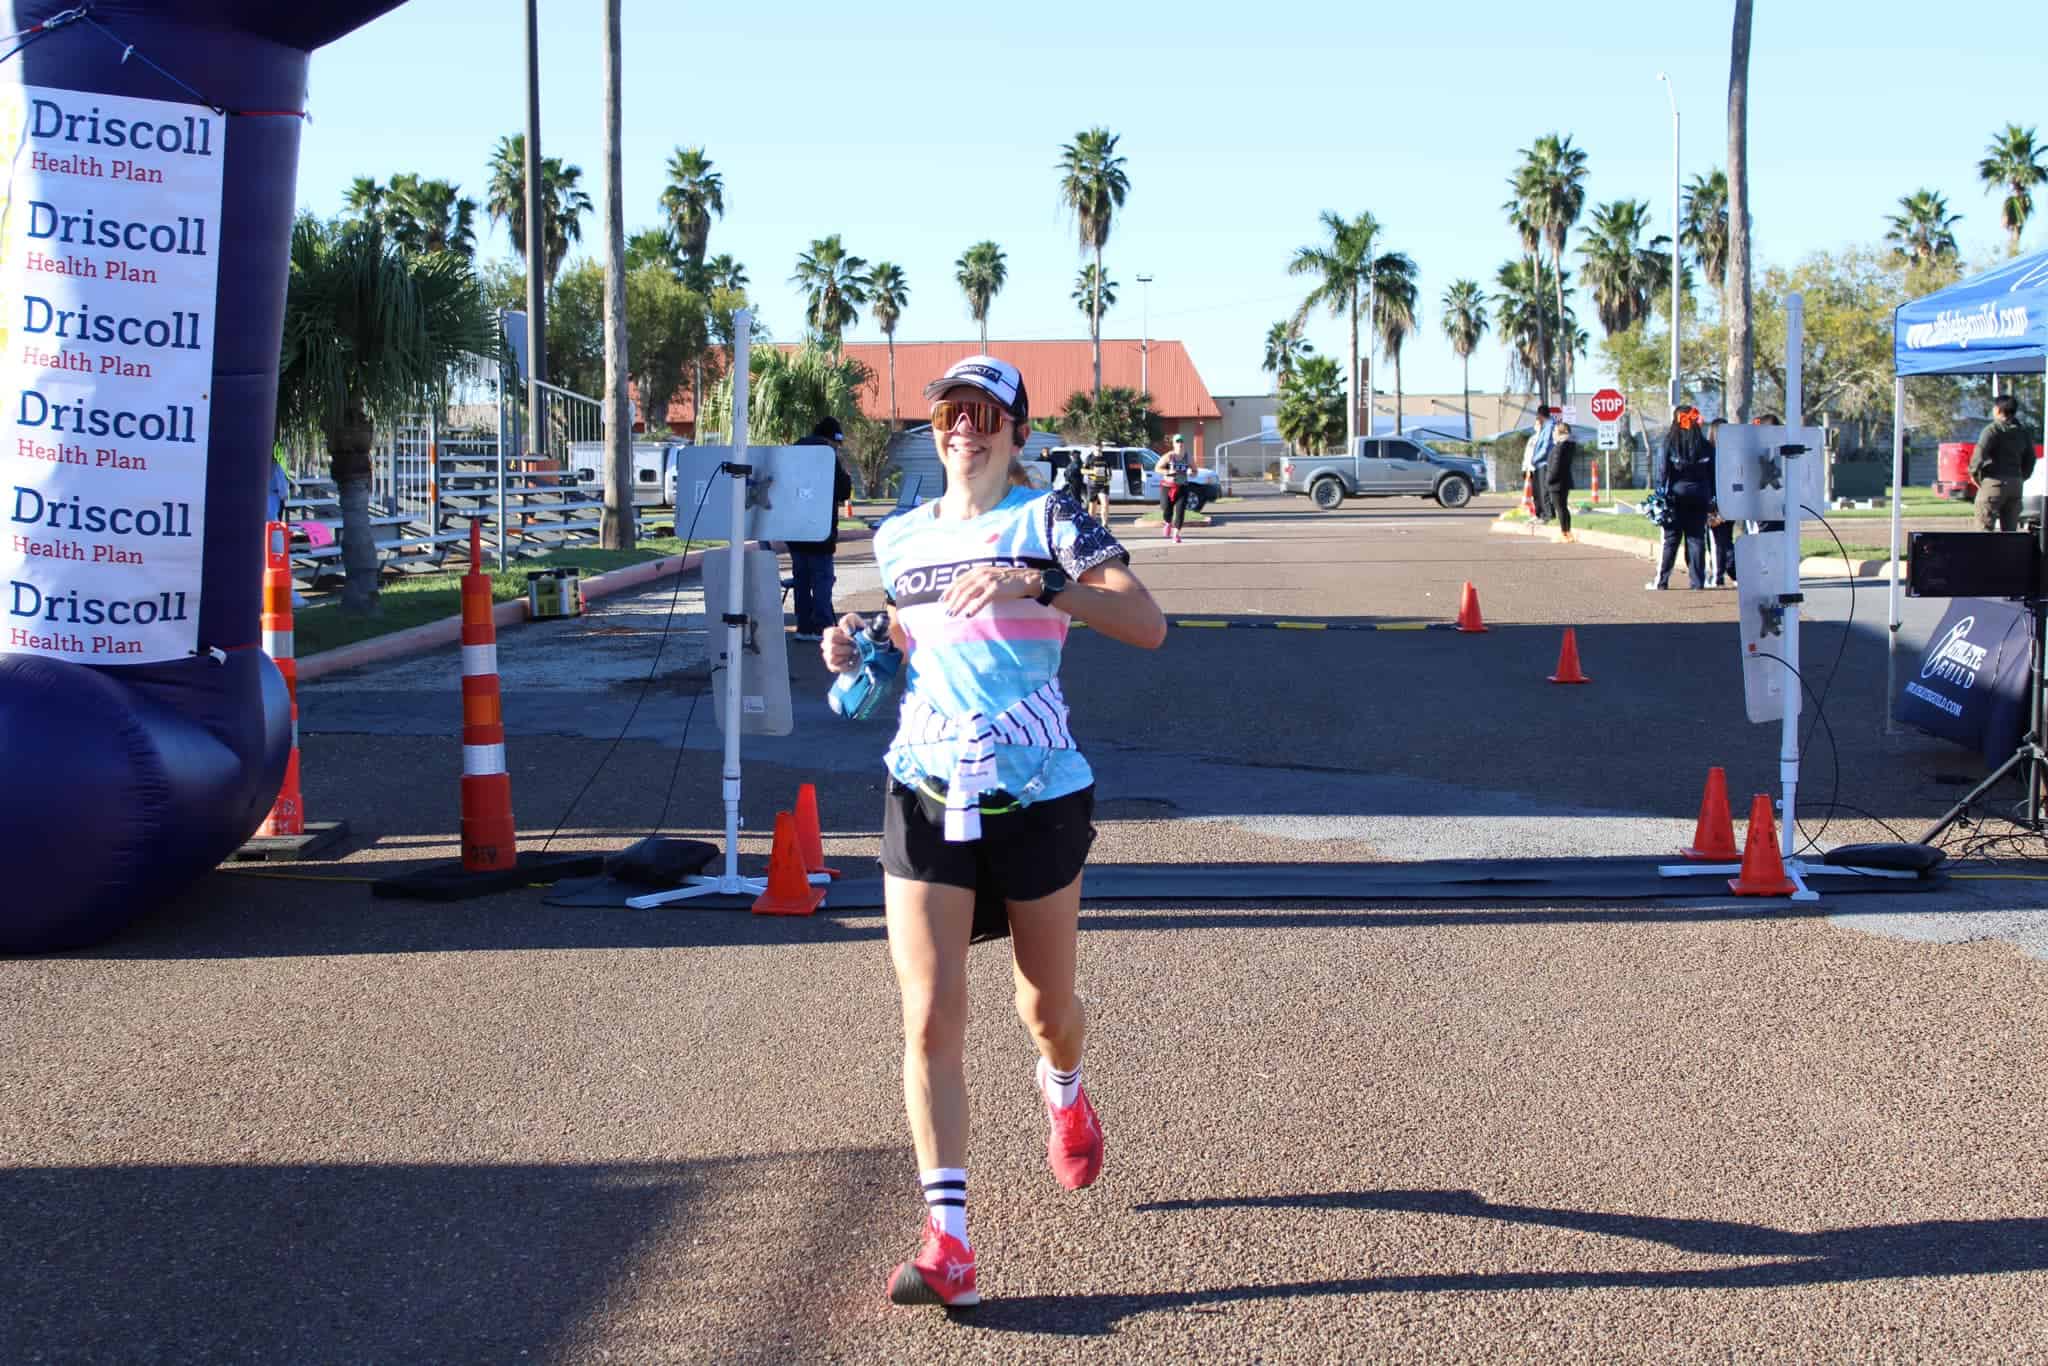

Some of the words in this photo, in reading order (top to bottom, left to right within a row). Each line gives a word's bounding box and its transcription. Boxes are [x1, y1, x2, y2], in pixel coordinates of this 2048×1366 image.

[31, 99, 212, 156] Driscoll
[31, 151, 104, 178] Health
[110, 159, 164, 184] Plan
[27, 201, 207, 256] Driscoll
[26, 253, 97, 277] Health
[104, 260, 157, 284] Plan
[23, 295, 201, 350] Driscoll
[23, 346, 92, 373] Health
[99, 355, 152, 378] Plan
[17, 390, 196, 443] Driscoll
[1593, 398, 1622, 412] STOP
[17, 438, 88, 465] Health
[95, 449, 147, 471] Plan
[11, 486, 192, 537] Driscoll
[12, 535, 84, 561] Health
[91, 545, 144, 564] Plan
[10, 580, 187, 625] Driscoll
[11, 628, 84, 652] Health
[91, 636, 143, 653] Plan
[1935, 659, 1975, 689] GUILD
